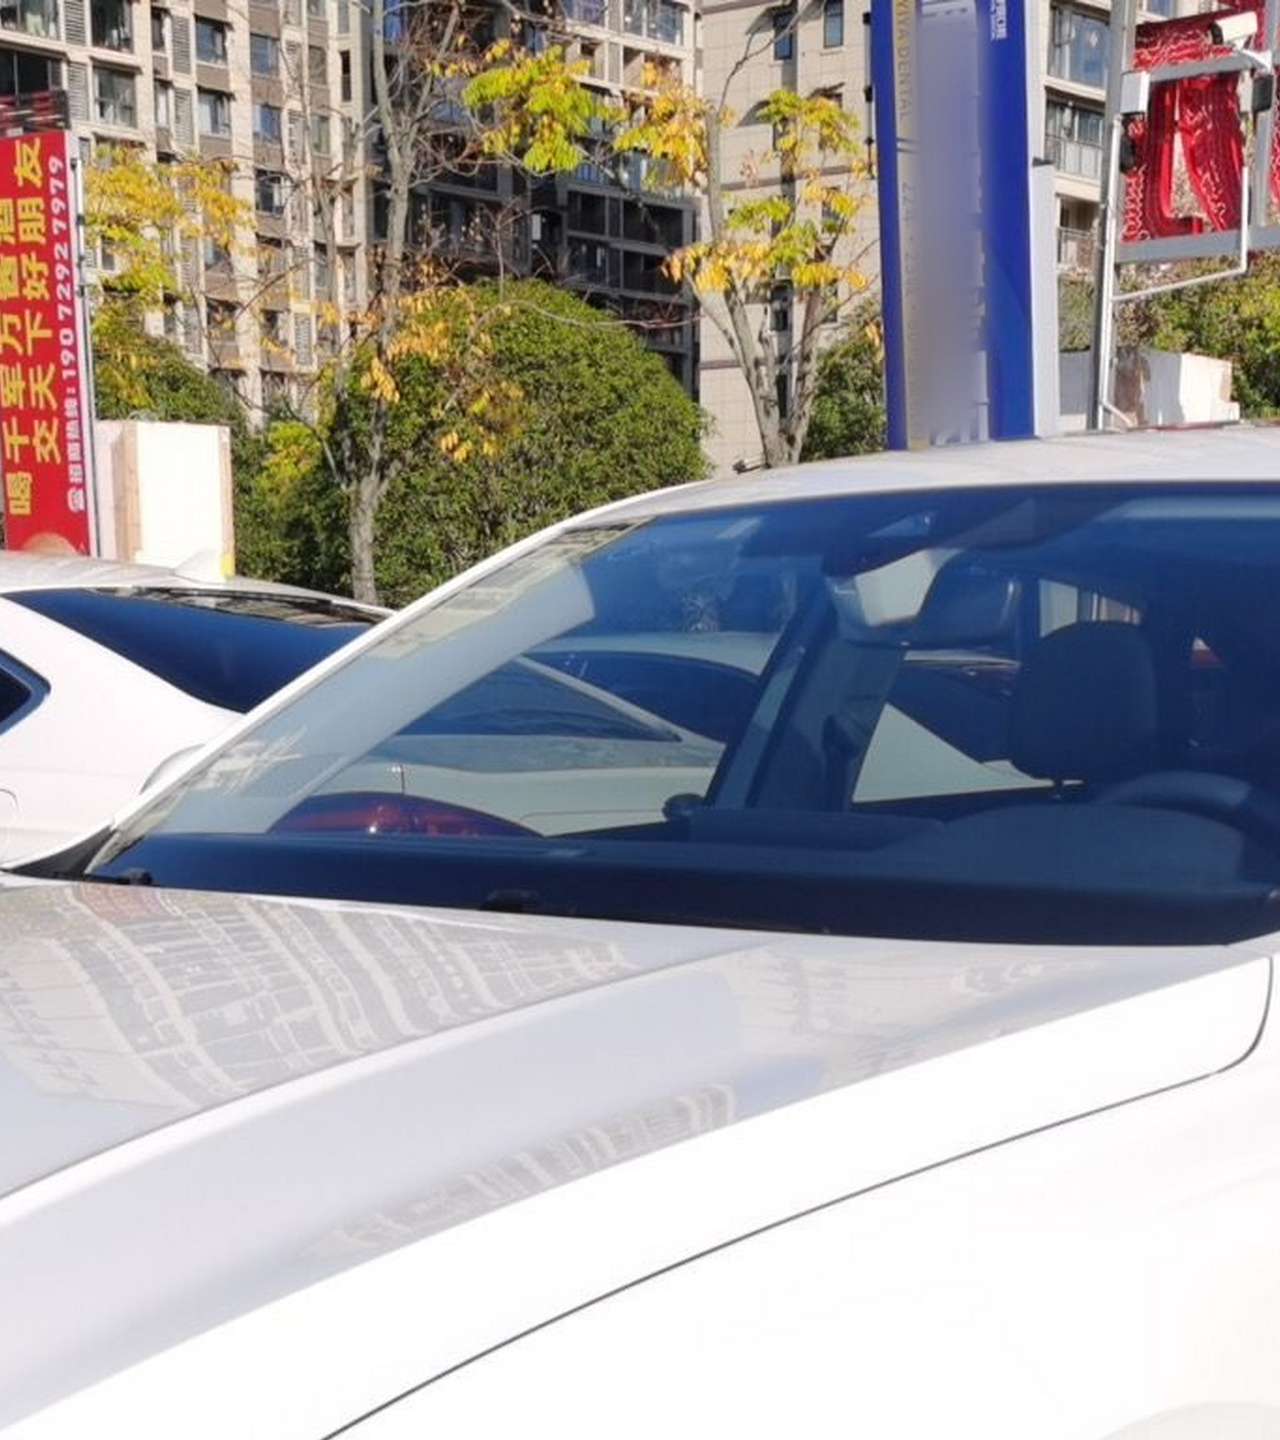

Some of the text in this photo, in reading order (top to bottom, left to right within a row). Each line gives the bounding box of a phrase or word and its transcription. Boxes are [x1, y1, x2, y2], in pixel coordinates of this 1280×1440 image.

[897, 46, 913, 121] DENTAL
[48, 154, 68, 236] 7979
[14, 137, 61, 464] 交天下好朋友
